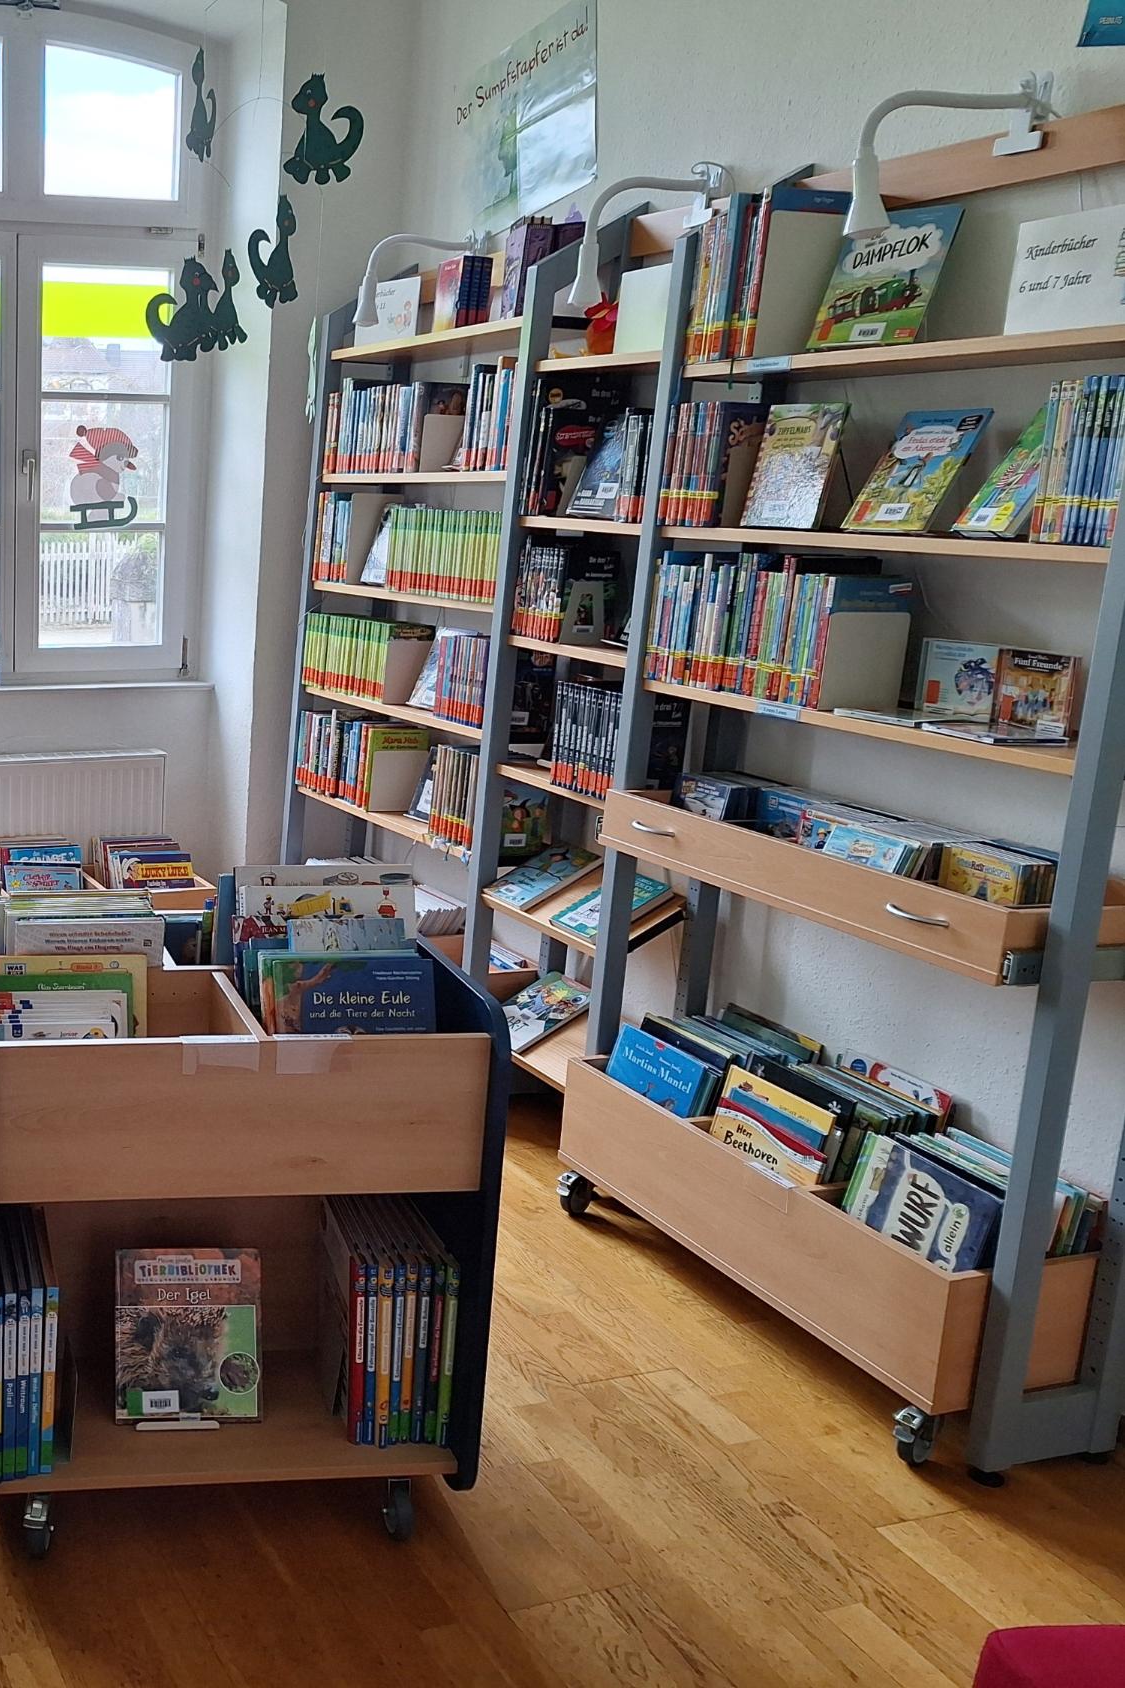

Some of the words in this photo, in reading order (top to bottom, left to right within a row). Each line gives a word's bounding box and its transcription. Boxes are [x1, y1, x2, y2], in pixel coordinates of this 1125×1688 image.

[456, 101, 473, 125] Der
[475, 39, 554, 108] Sumpfstapfer
[556, 29, 568, 52] ist
[571, 5, 588, 41] da!
[852, 231, 933, 270] DAMPFLOK
[1024, 234, 1098, 261] Kinderbücher
[1018, 281, 1027, 294] 6
[1029, 276, 1051, 292] und
[1052, 275, 1061, 289] 7
[1060, 270, 1092, 291] Jahre
[141, 866, 166, 878] LUCKY
[167, 866, 189, 877] LUKE
[313, 992, 333, 1005] Die
[339, 991, 375, 1005] kleine
[381, 990, 411, 1004] Eule
[309, 1008, 326, 1018] und
[329, 1008, 342, 1018] die
[346, 1008, 367, 1018] Tiere
[371, 1008, 385, 1018] der
[388, 1008, 416, 1018] Nacht
[622, 1046, 657, 1076] Martins
[658, 1065, 693, 1094] Mantel
[736, 1123, 753, 1139] Herr
[722, 1129, 779, 1166] Beethoven
[891, 1173, 941, 1251] WURF
[944, 1220, 962, 1253] allein
[158, 1288, 181, 1301] Der
[186, 1287, 212, 1303] Igel
[20, 1380, 28, 1414] Weltraum
